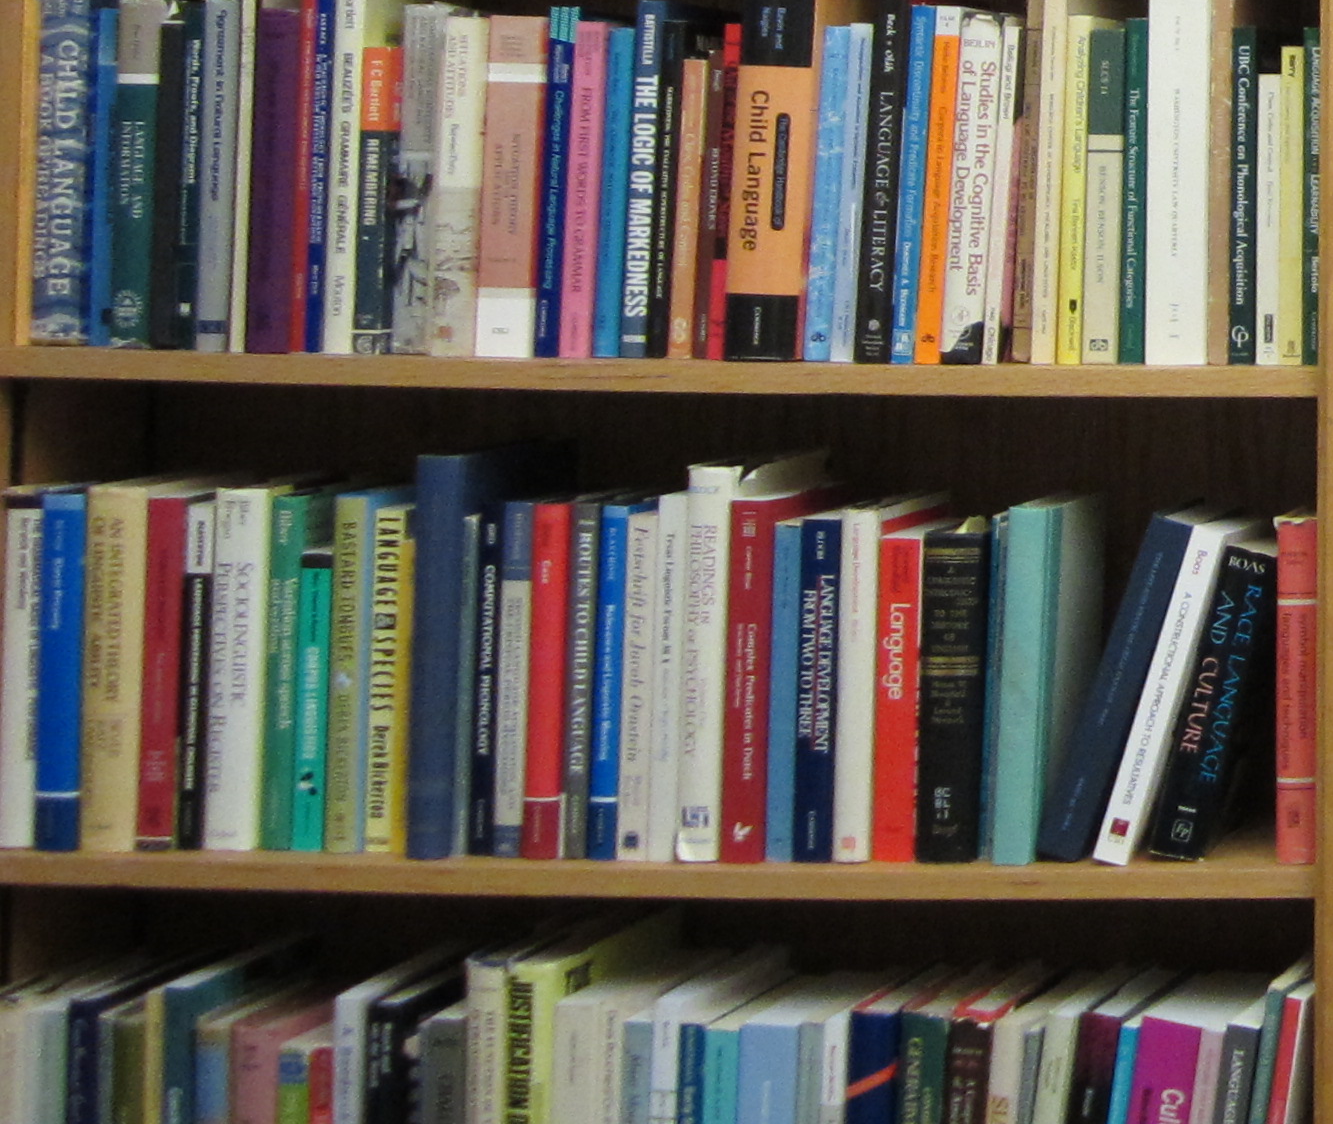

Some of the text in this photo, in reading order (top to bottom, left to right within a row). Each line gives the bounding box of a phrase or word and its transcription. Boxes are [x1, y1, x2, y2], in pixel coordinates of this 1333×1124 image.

[46, 40, 80, 295] CHILD LANGUAGE
[363, 138, 380, 226] REMEMBERING
[623, 14, 658, 317] BATTISTELLA THE LOGIC OF MARKEDNESS
[741, 90, 770, 251] Child Language
[874, 91, 894, 188] LANGUAGE
[948, 61, 978, 271] of Language Development
[966, 61, 996, 295] Studies in the Cognitive Basis
[868, 209, 889, 292] LITERACY
[1228, 556, 1267, 575] BOAS
[813, 575, 835, 754] LANGUAGE DEVELOPMENT
[883, 603, 910, 700] Language
[1179, 591, 1236, 755] AND CULTURE
[1199, 654, 1246, 784] LANGUAGE
